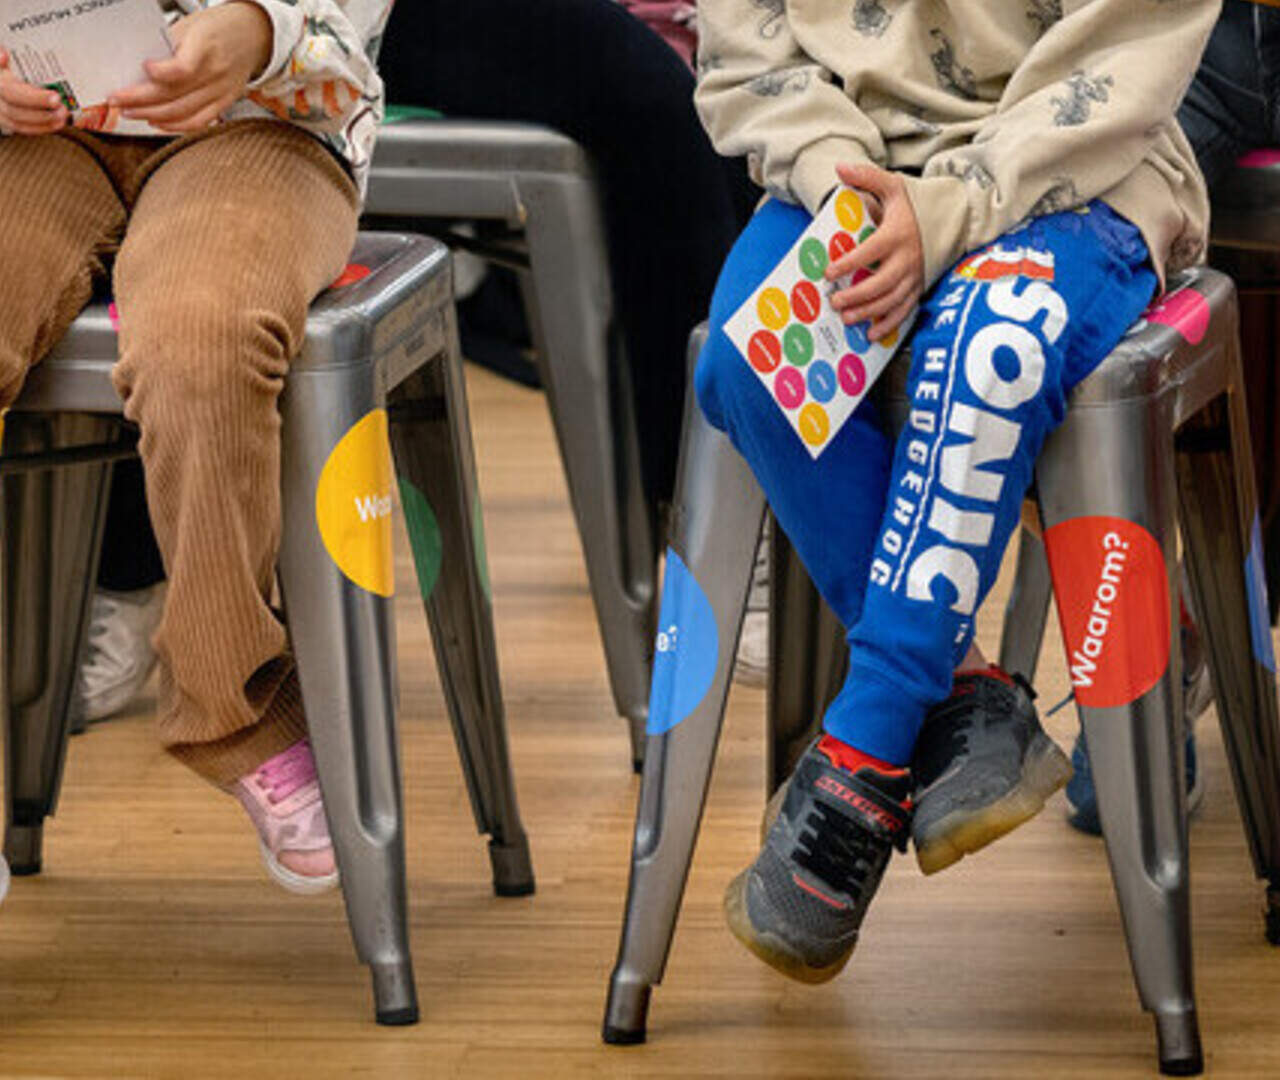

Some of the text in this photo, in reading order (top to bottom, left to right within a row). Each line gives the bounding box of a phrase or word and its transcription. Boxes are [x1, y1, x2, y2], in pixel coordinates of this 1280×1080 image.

[8, 5, 71, 32] MUSEUM
[870, 347, 948, 587] HEDGEHOG
[906, 275, 1069, 616] SONIC
[1071, 531, 1131, 688] Waarom?
